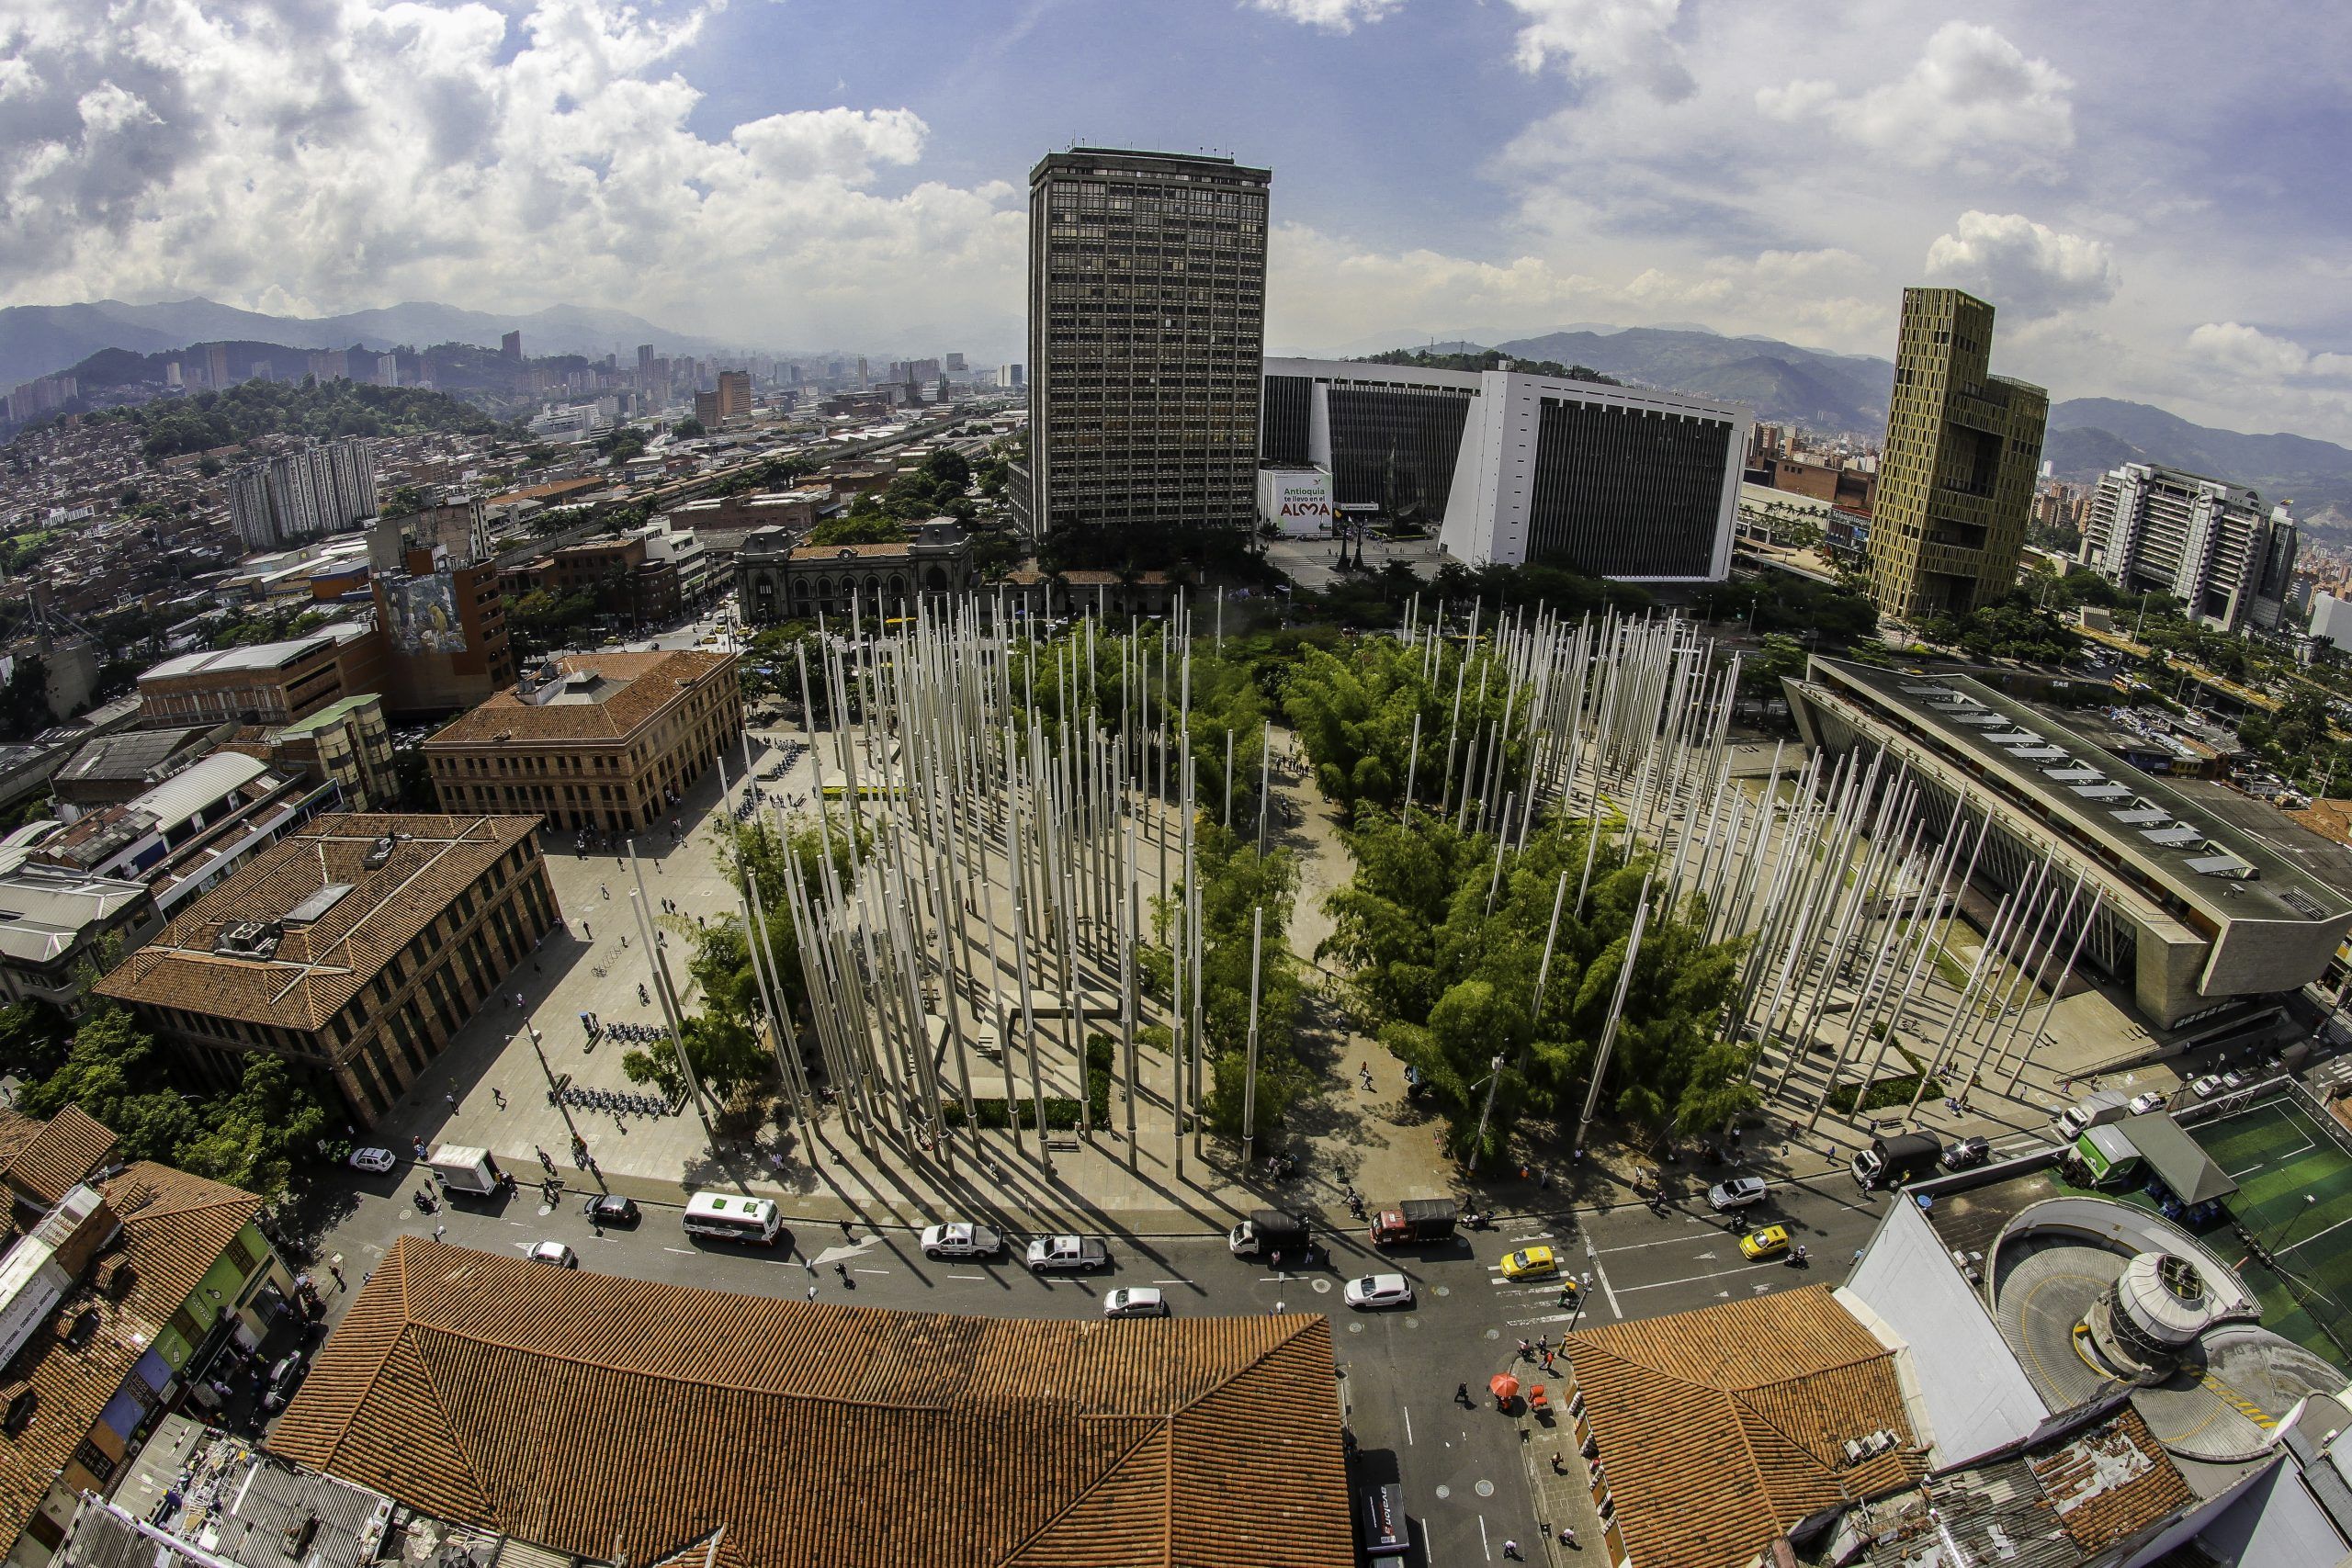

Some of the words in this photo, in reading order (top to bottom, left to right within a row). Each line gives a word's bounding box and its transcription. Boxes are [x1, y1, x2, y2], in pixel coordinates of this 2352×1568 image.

[1283, 487, 1325, 496] Antioquia
[1280, 503, 1330, 516] ALMA
[3, 1349, 14, 1362] 120
